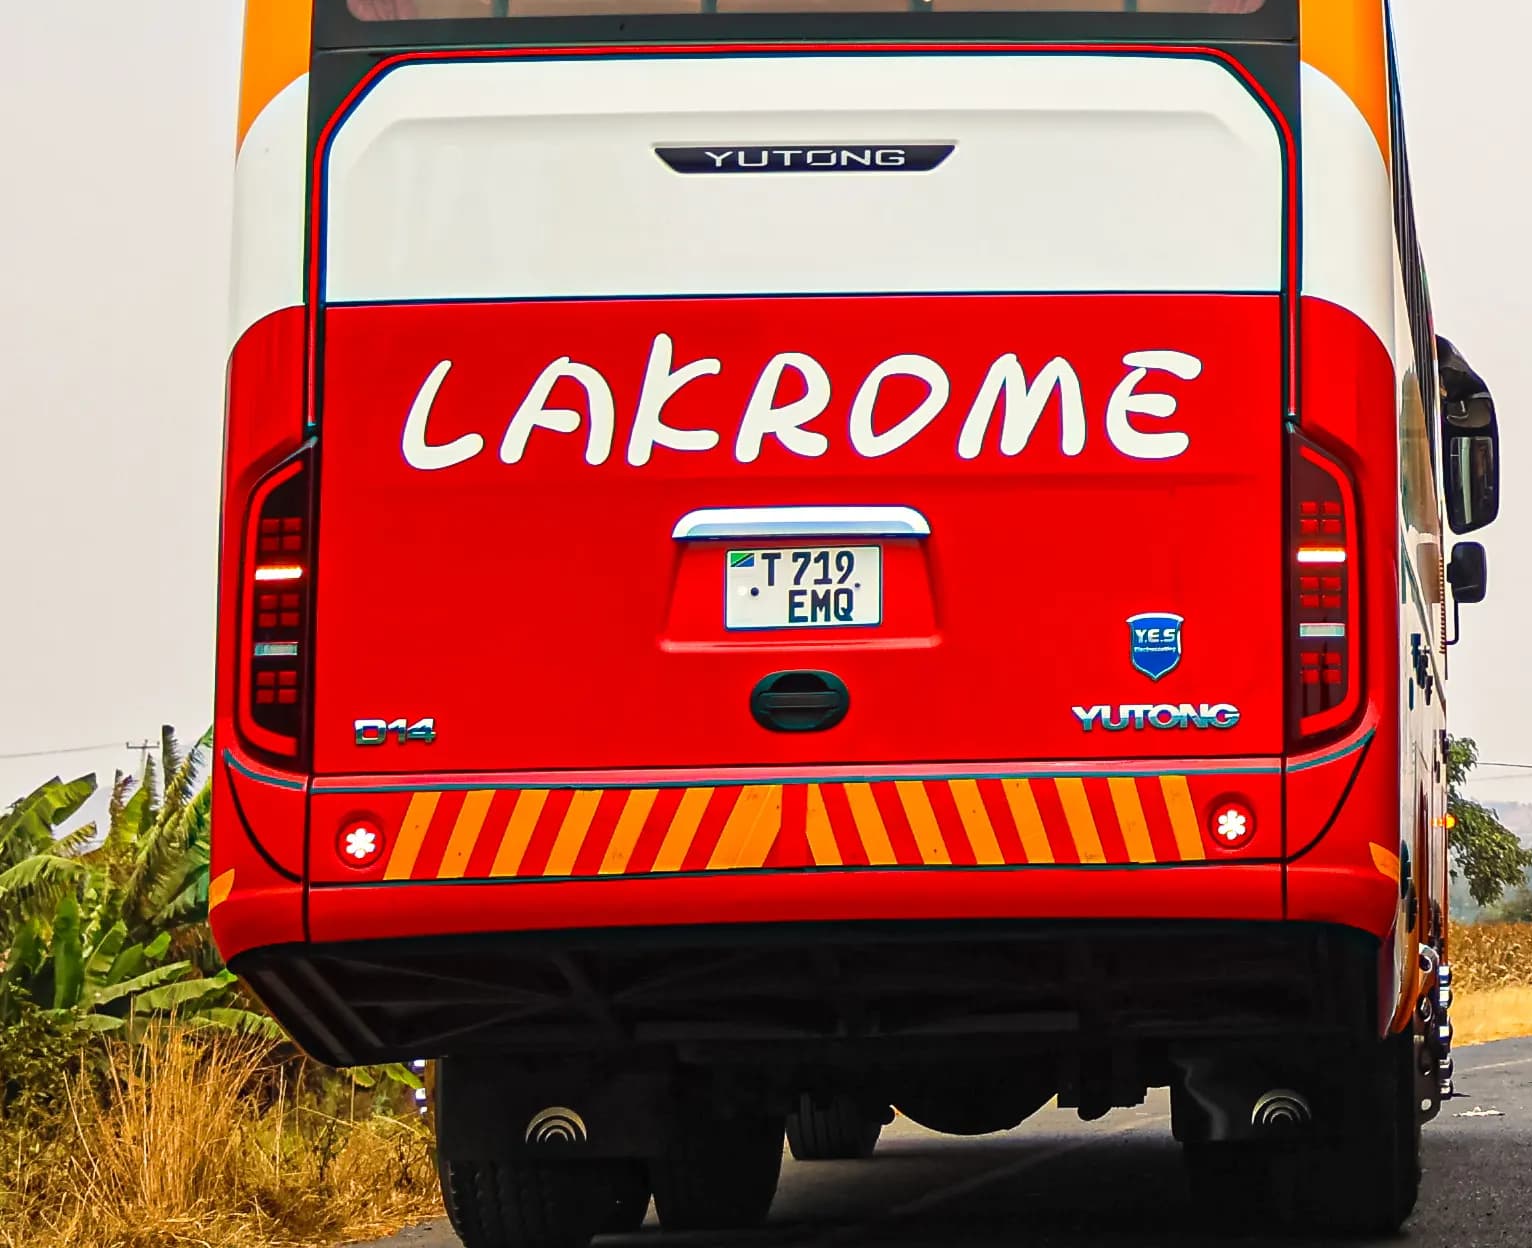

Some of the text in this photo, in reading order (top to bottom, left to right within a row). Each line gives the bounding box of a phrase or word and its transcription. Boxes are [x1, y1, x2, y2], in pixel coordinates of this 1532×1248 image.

[704, 149, 906, 167] YUTONG
[401, 332, 1203, 470] LAKROME
[761, 551, 855, 586] T 719
[788, 588, 853, 623] EMQ
[354, 718, 437, 744] D14
[1071, 703, 1241, 731] YUTONG
